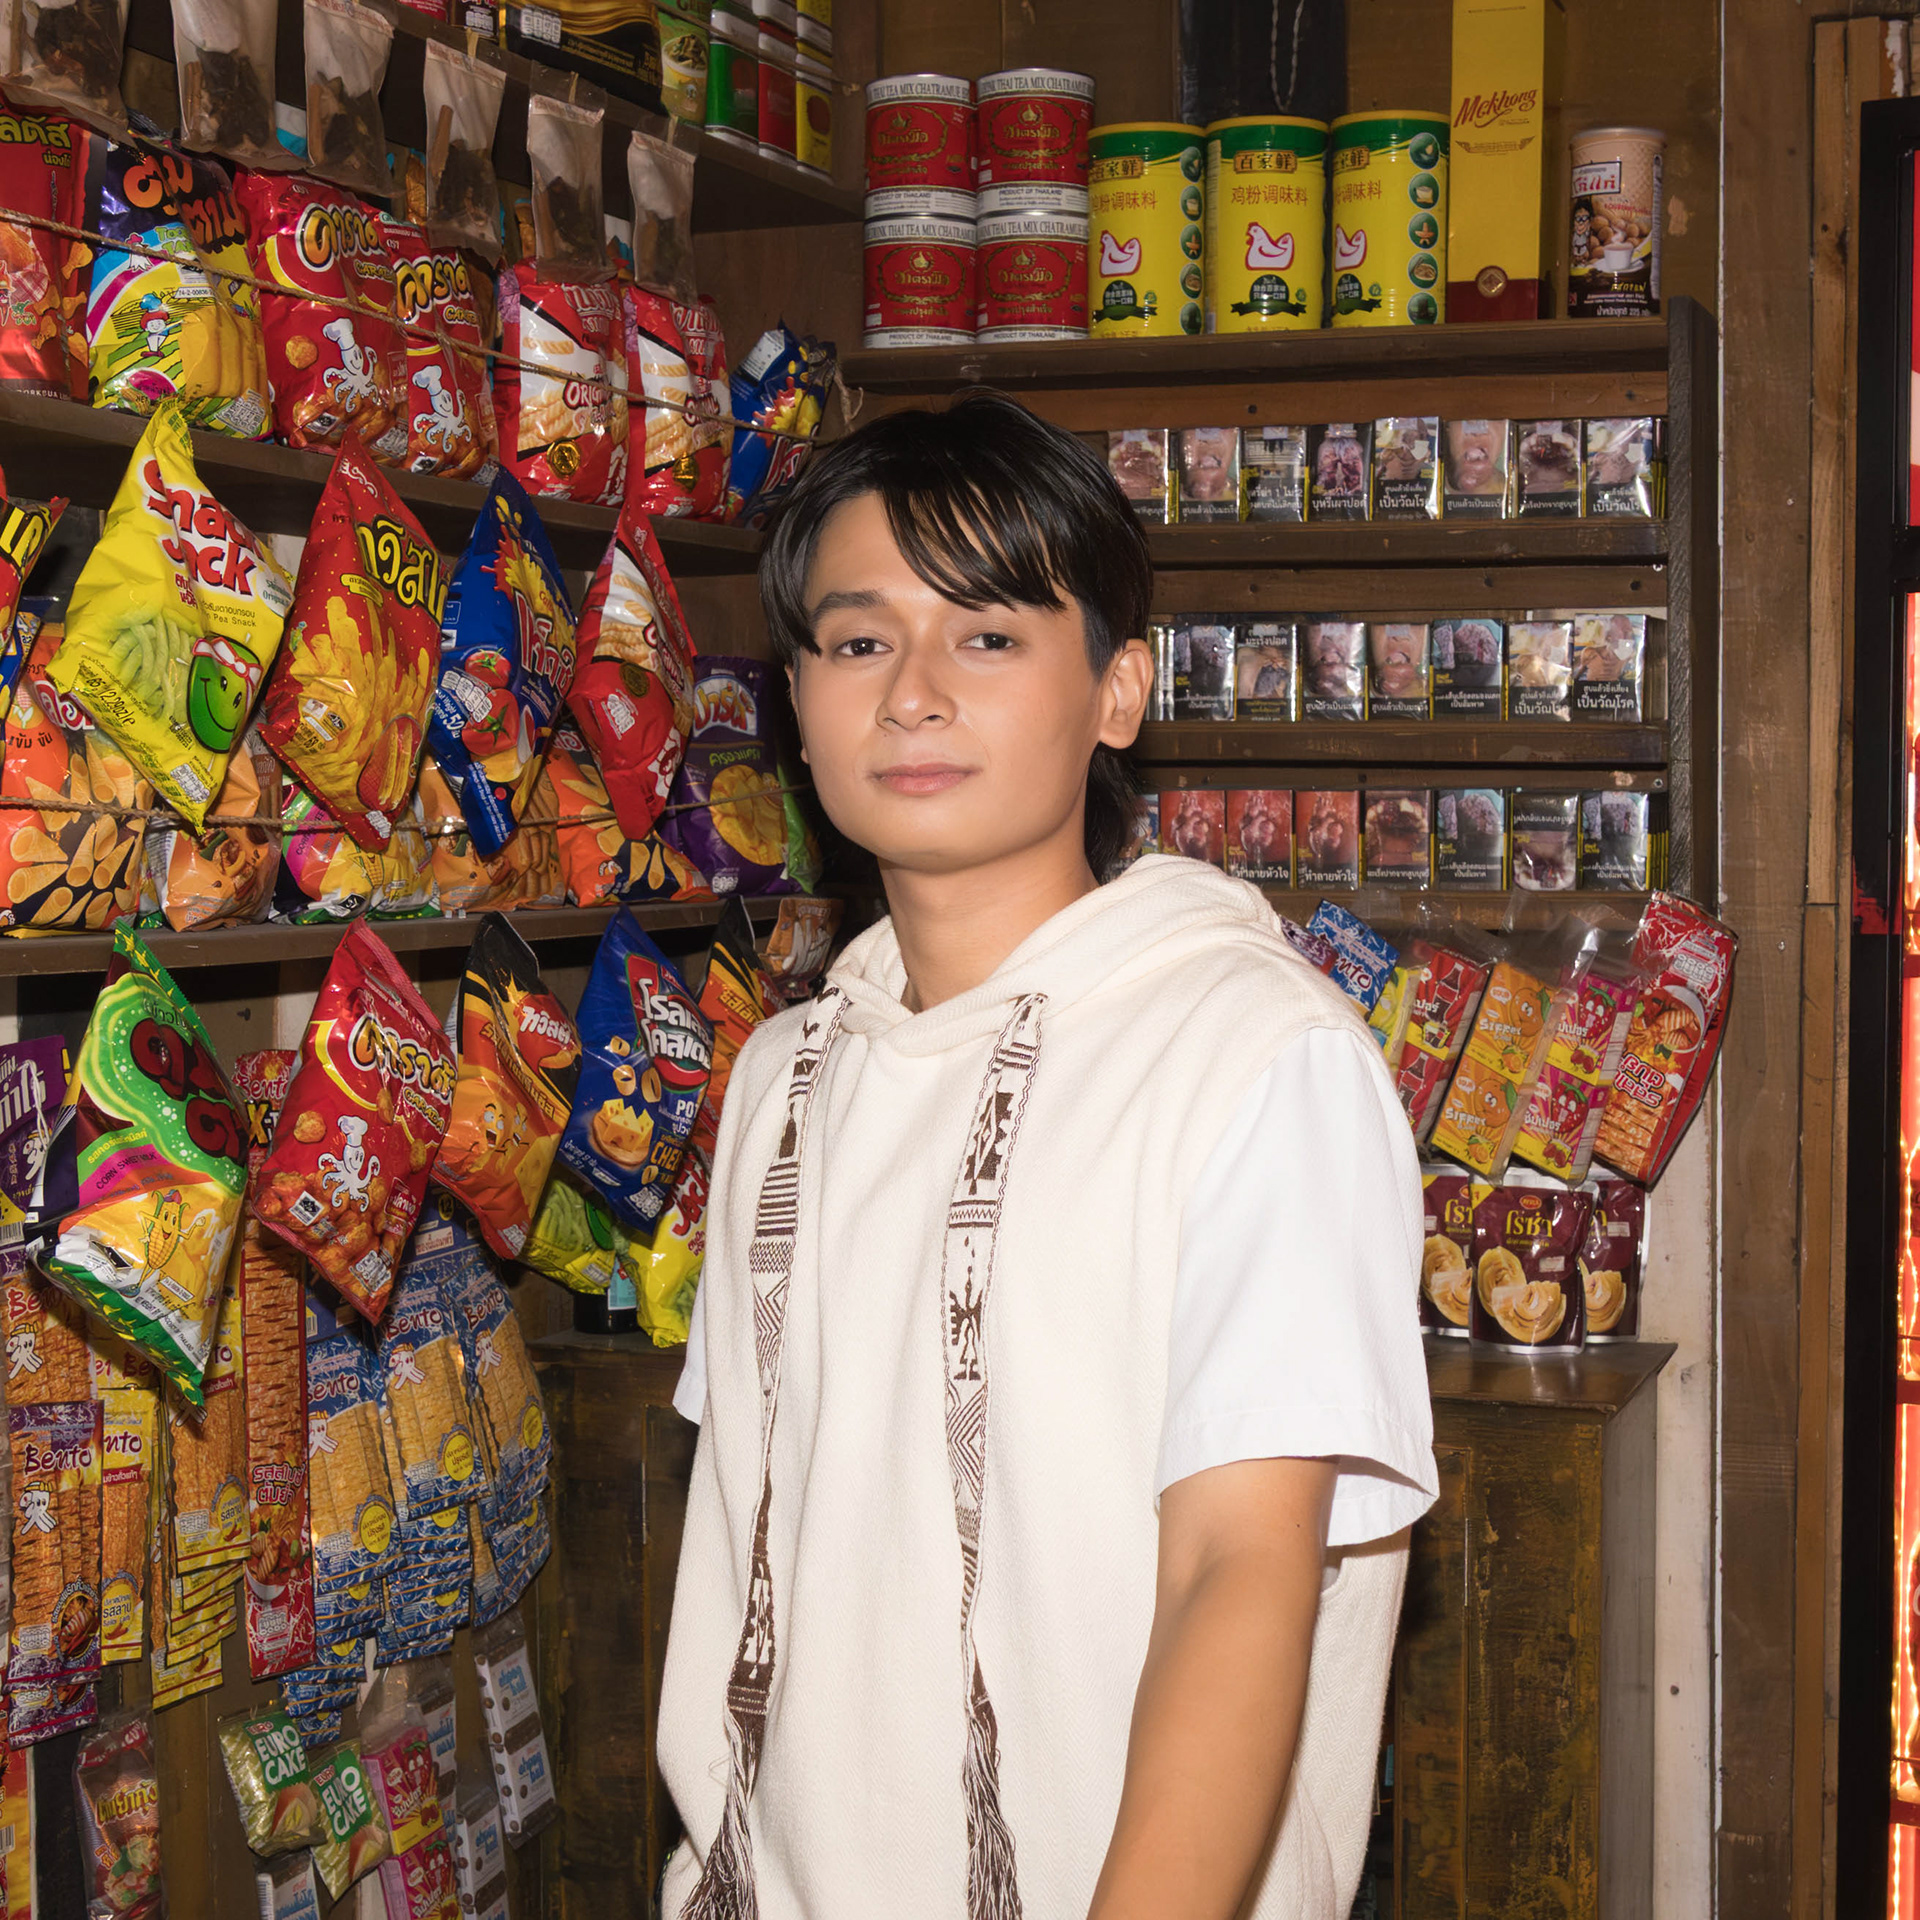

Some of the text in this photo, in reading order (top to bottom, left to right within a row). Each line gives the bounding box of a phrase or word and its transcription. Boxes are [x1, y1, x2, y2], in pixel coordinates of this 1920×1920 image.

[1453, 89, 1537, 128] Mekhong
[231, 616, 256, 627] Snack
[386, 1307, 443, 1341] Bento
[464, 1287, 504, 1331] Bento
[23, 1443, 91, 1475] Bento
[255, 1725, 300, 1762] EURO
[265, 1746, 306, 1785] CAKE
[322, 1766, 361, 1815] EURO
[333, 1788, 367, 1836] CAKE
